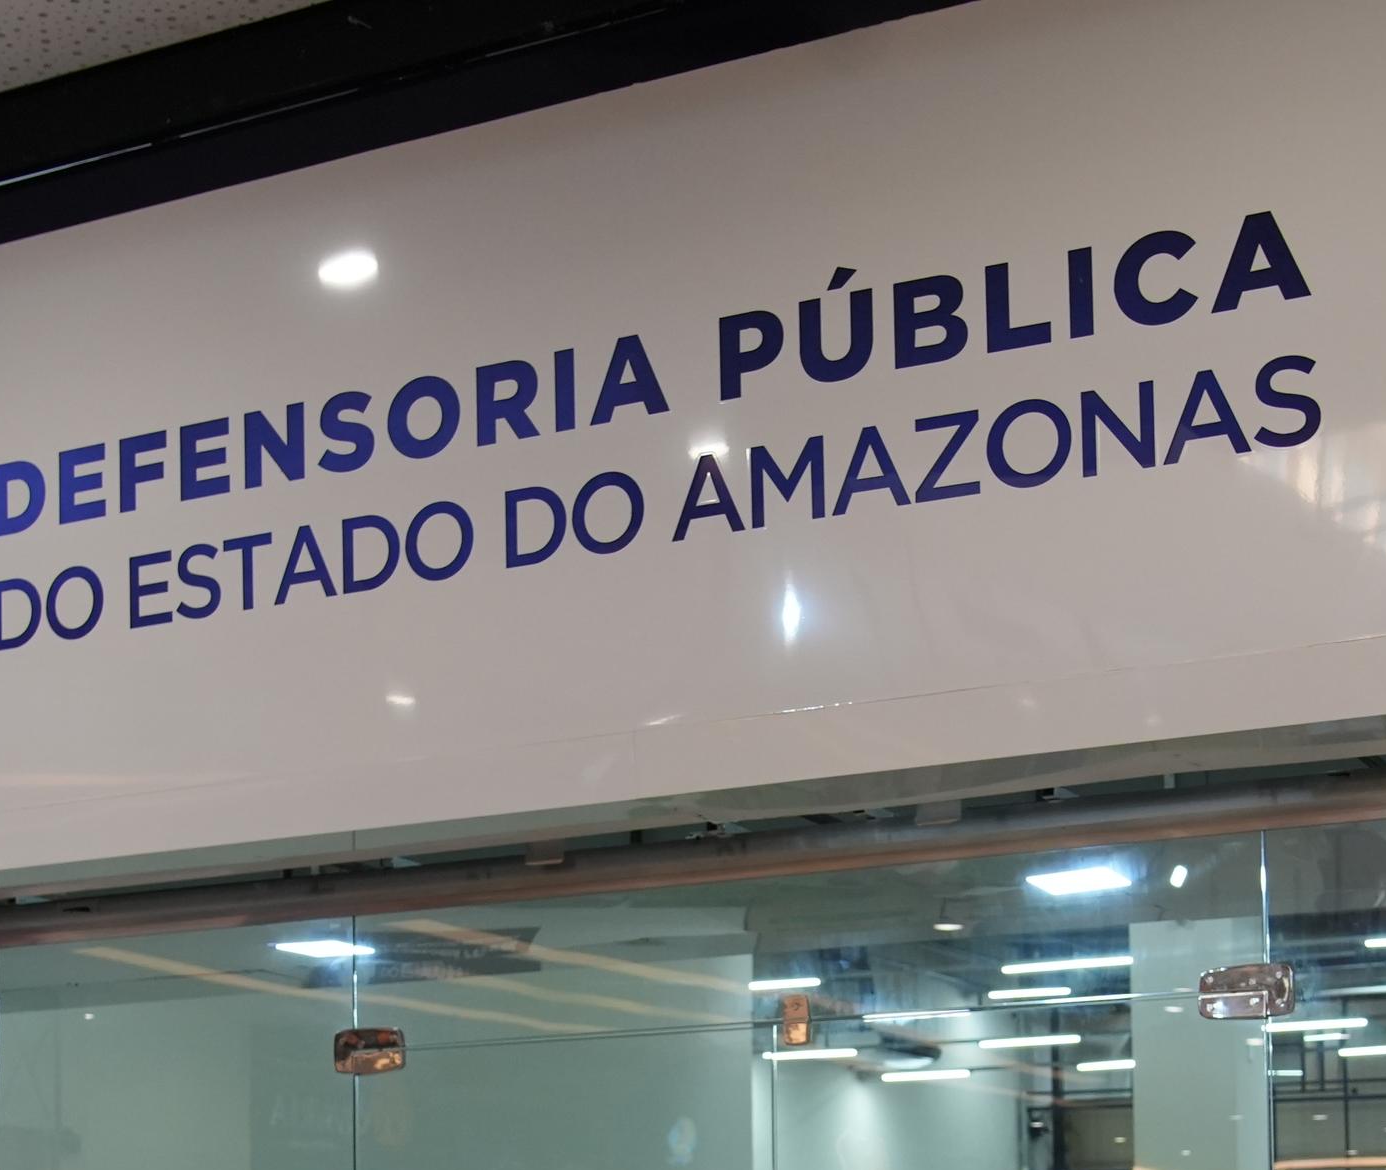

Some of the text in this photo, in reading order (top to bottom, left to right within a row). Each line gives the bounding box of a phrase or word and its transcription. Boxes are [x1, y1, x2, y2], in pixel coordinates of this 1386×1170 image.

[718, 210, 1313, 402] PÚBLICA
[129, 500, 475, 630] ESTADO
[505, 470, 645, 568] DO
[672, 354, 1323, 542] AMAZONAS
